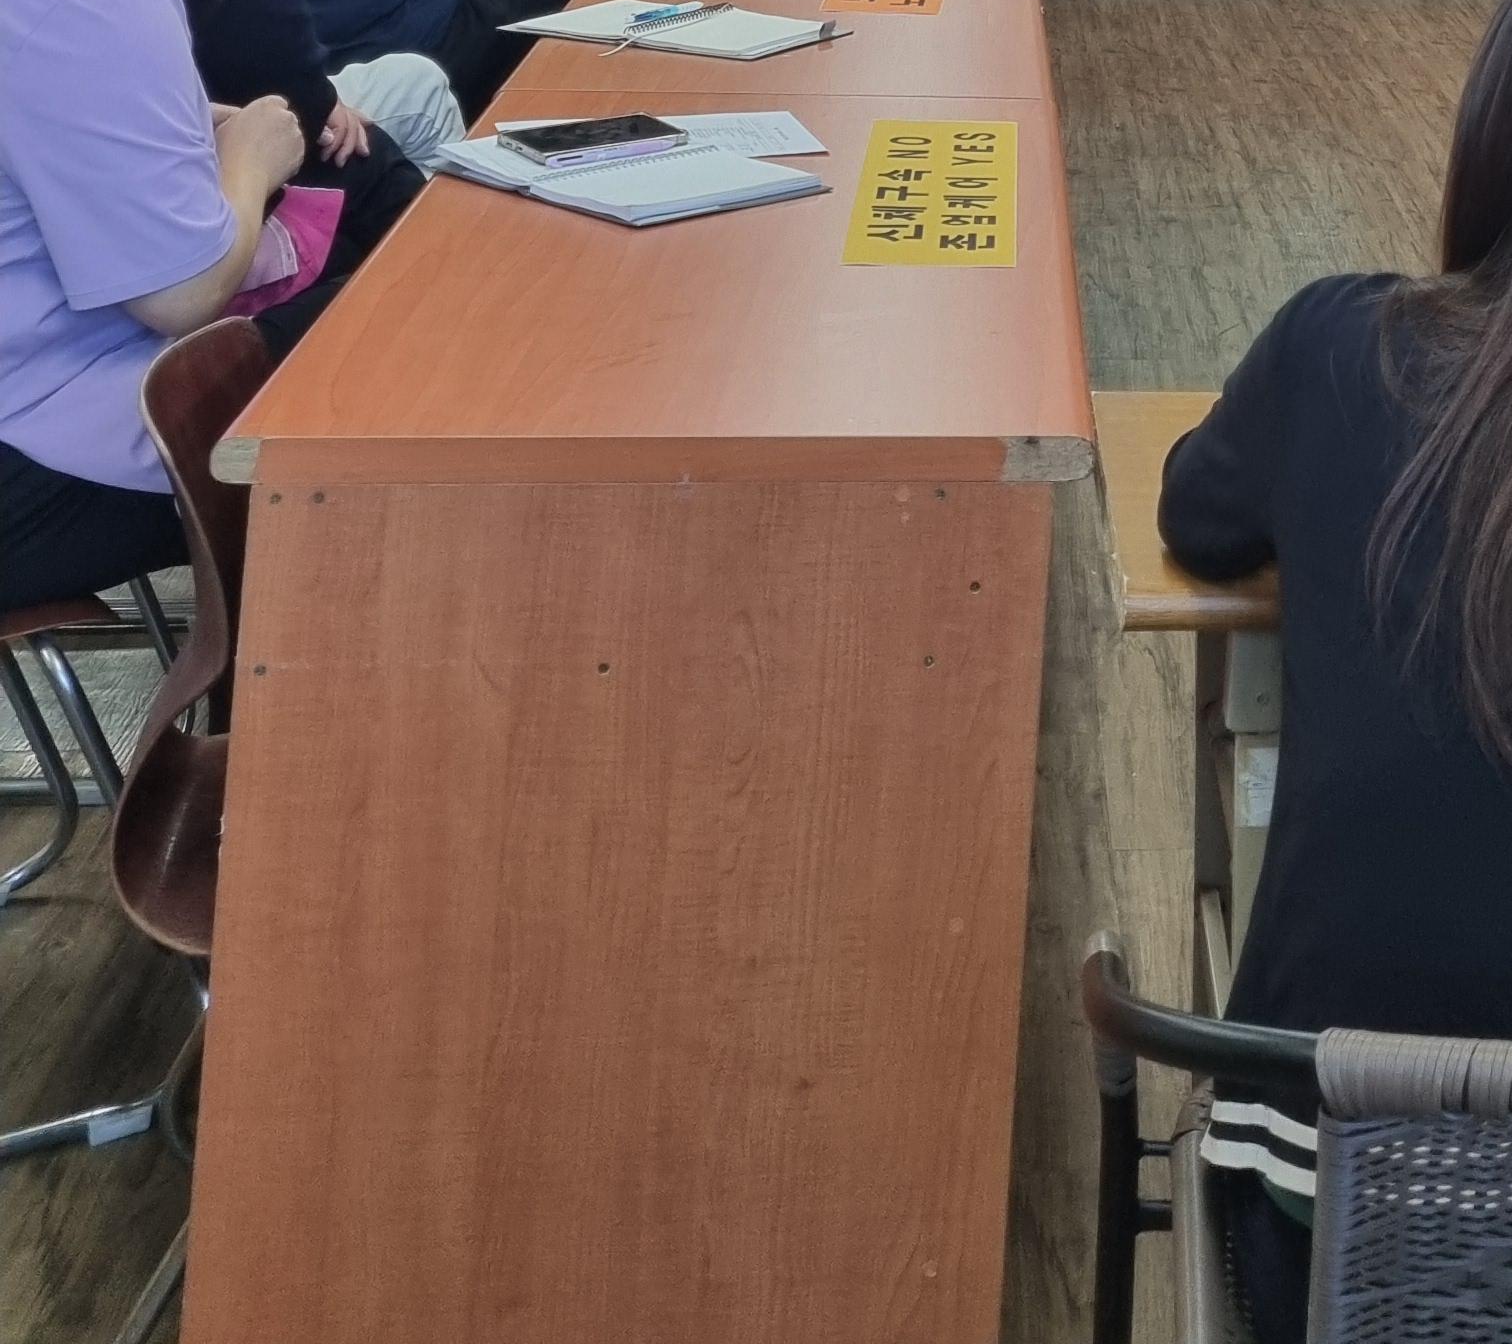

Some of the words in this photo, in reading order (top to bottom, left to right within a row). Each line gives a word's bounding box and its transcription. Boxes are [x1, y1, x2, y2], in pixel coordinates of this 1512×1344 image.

[886, 135, 933, 159] NO
[951, 132, 997, 167] YES
[866, 169, 933, 242] 신체구속
[939, 176, 999, 251] 존엄케어
